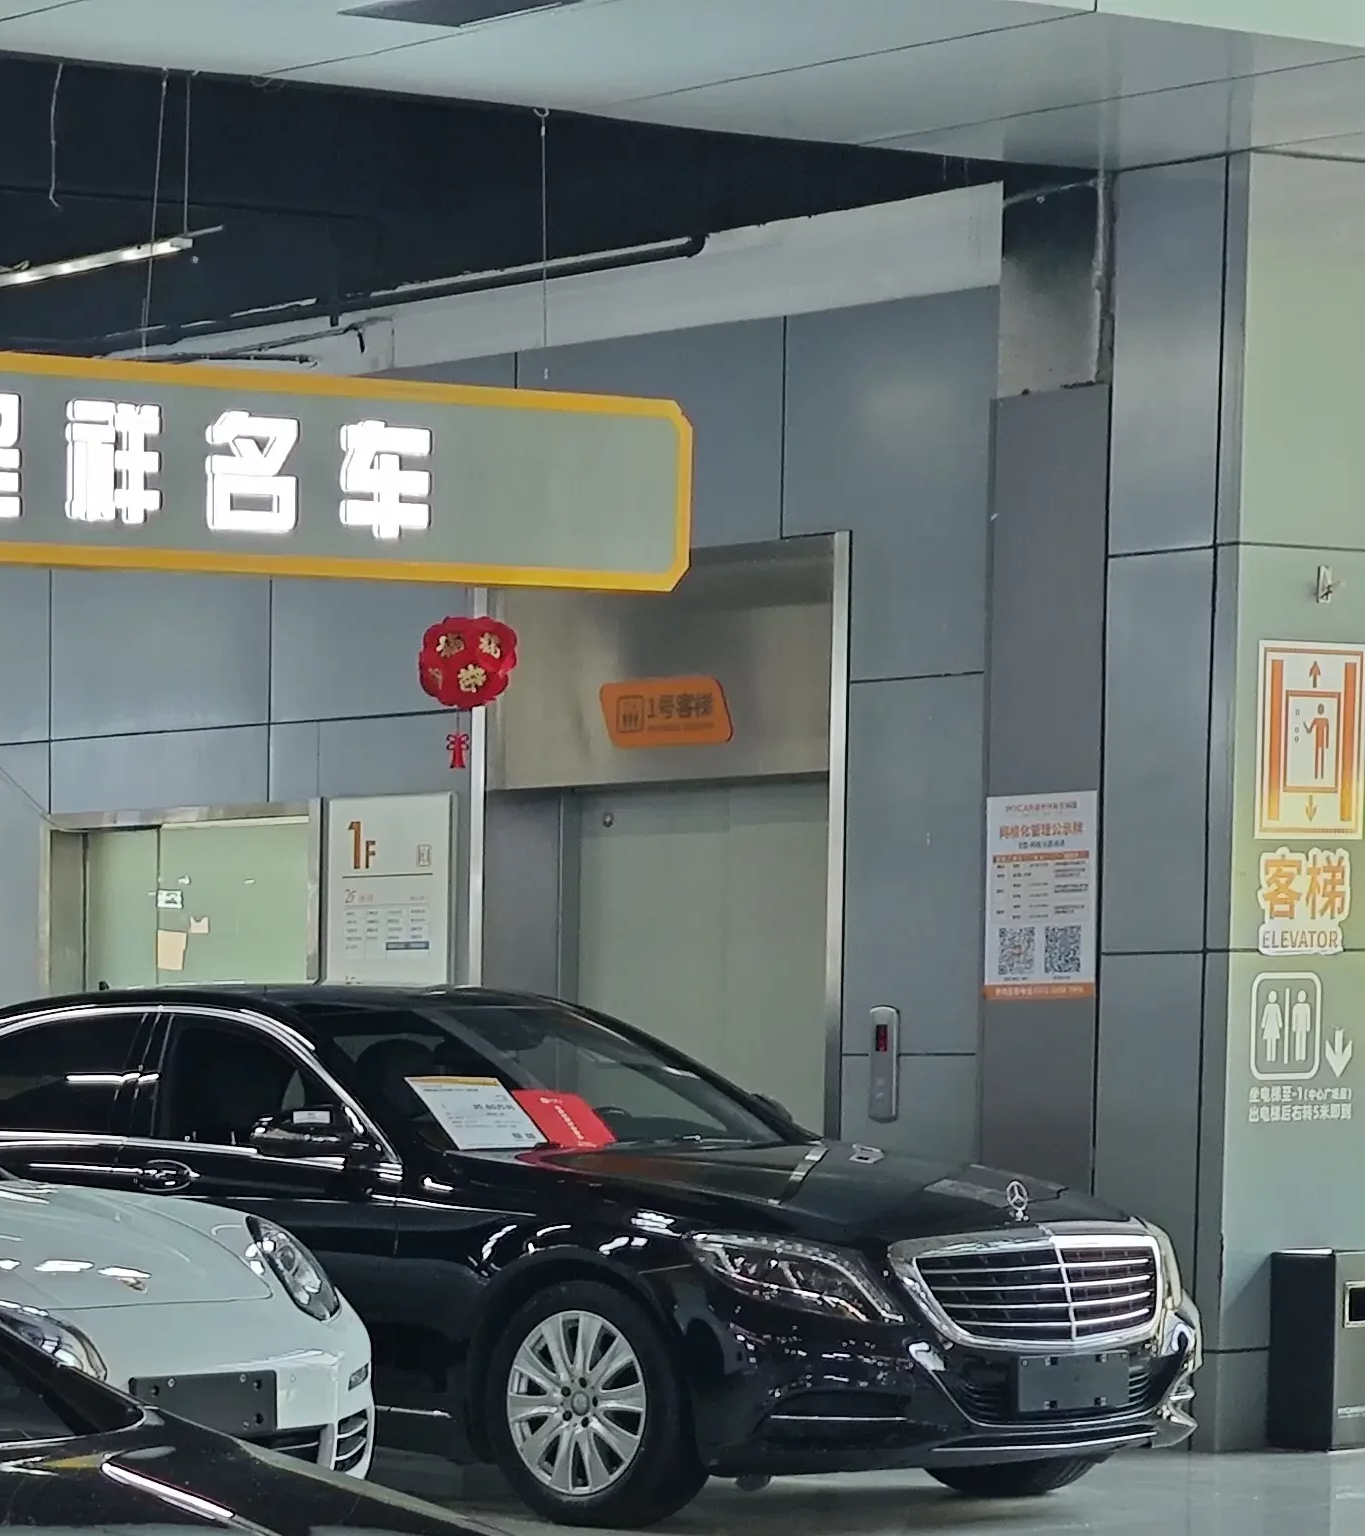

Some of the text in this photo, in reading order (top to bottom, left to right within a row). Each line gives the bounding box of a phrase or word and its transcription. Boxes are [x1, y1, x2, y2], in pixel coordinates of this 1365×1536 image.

[647, 692, 713, 719] 1号客梯
[347, 821, 377, 870] 1F
[1262, 854, 1346, 921] 客梯
[1262, 930, 1339, 949] ELEVATOR
